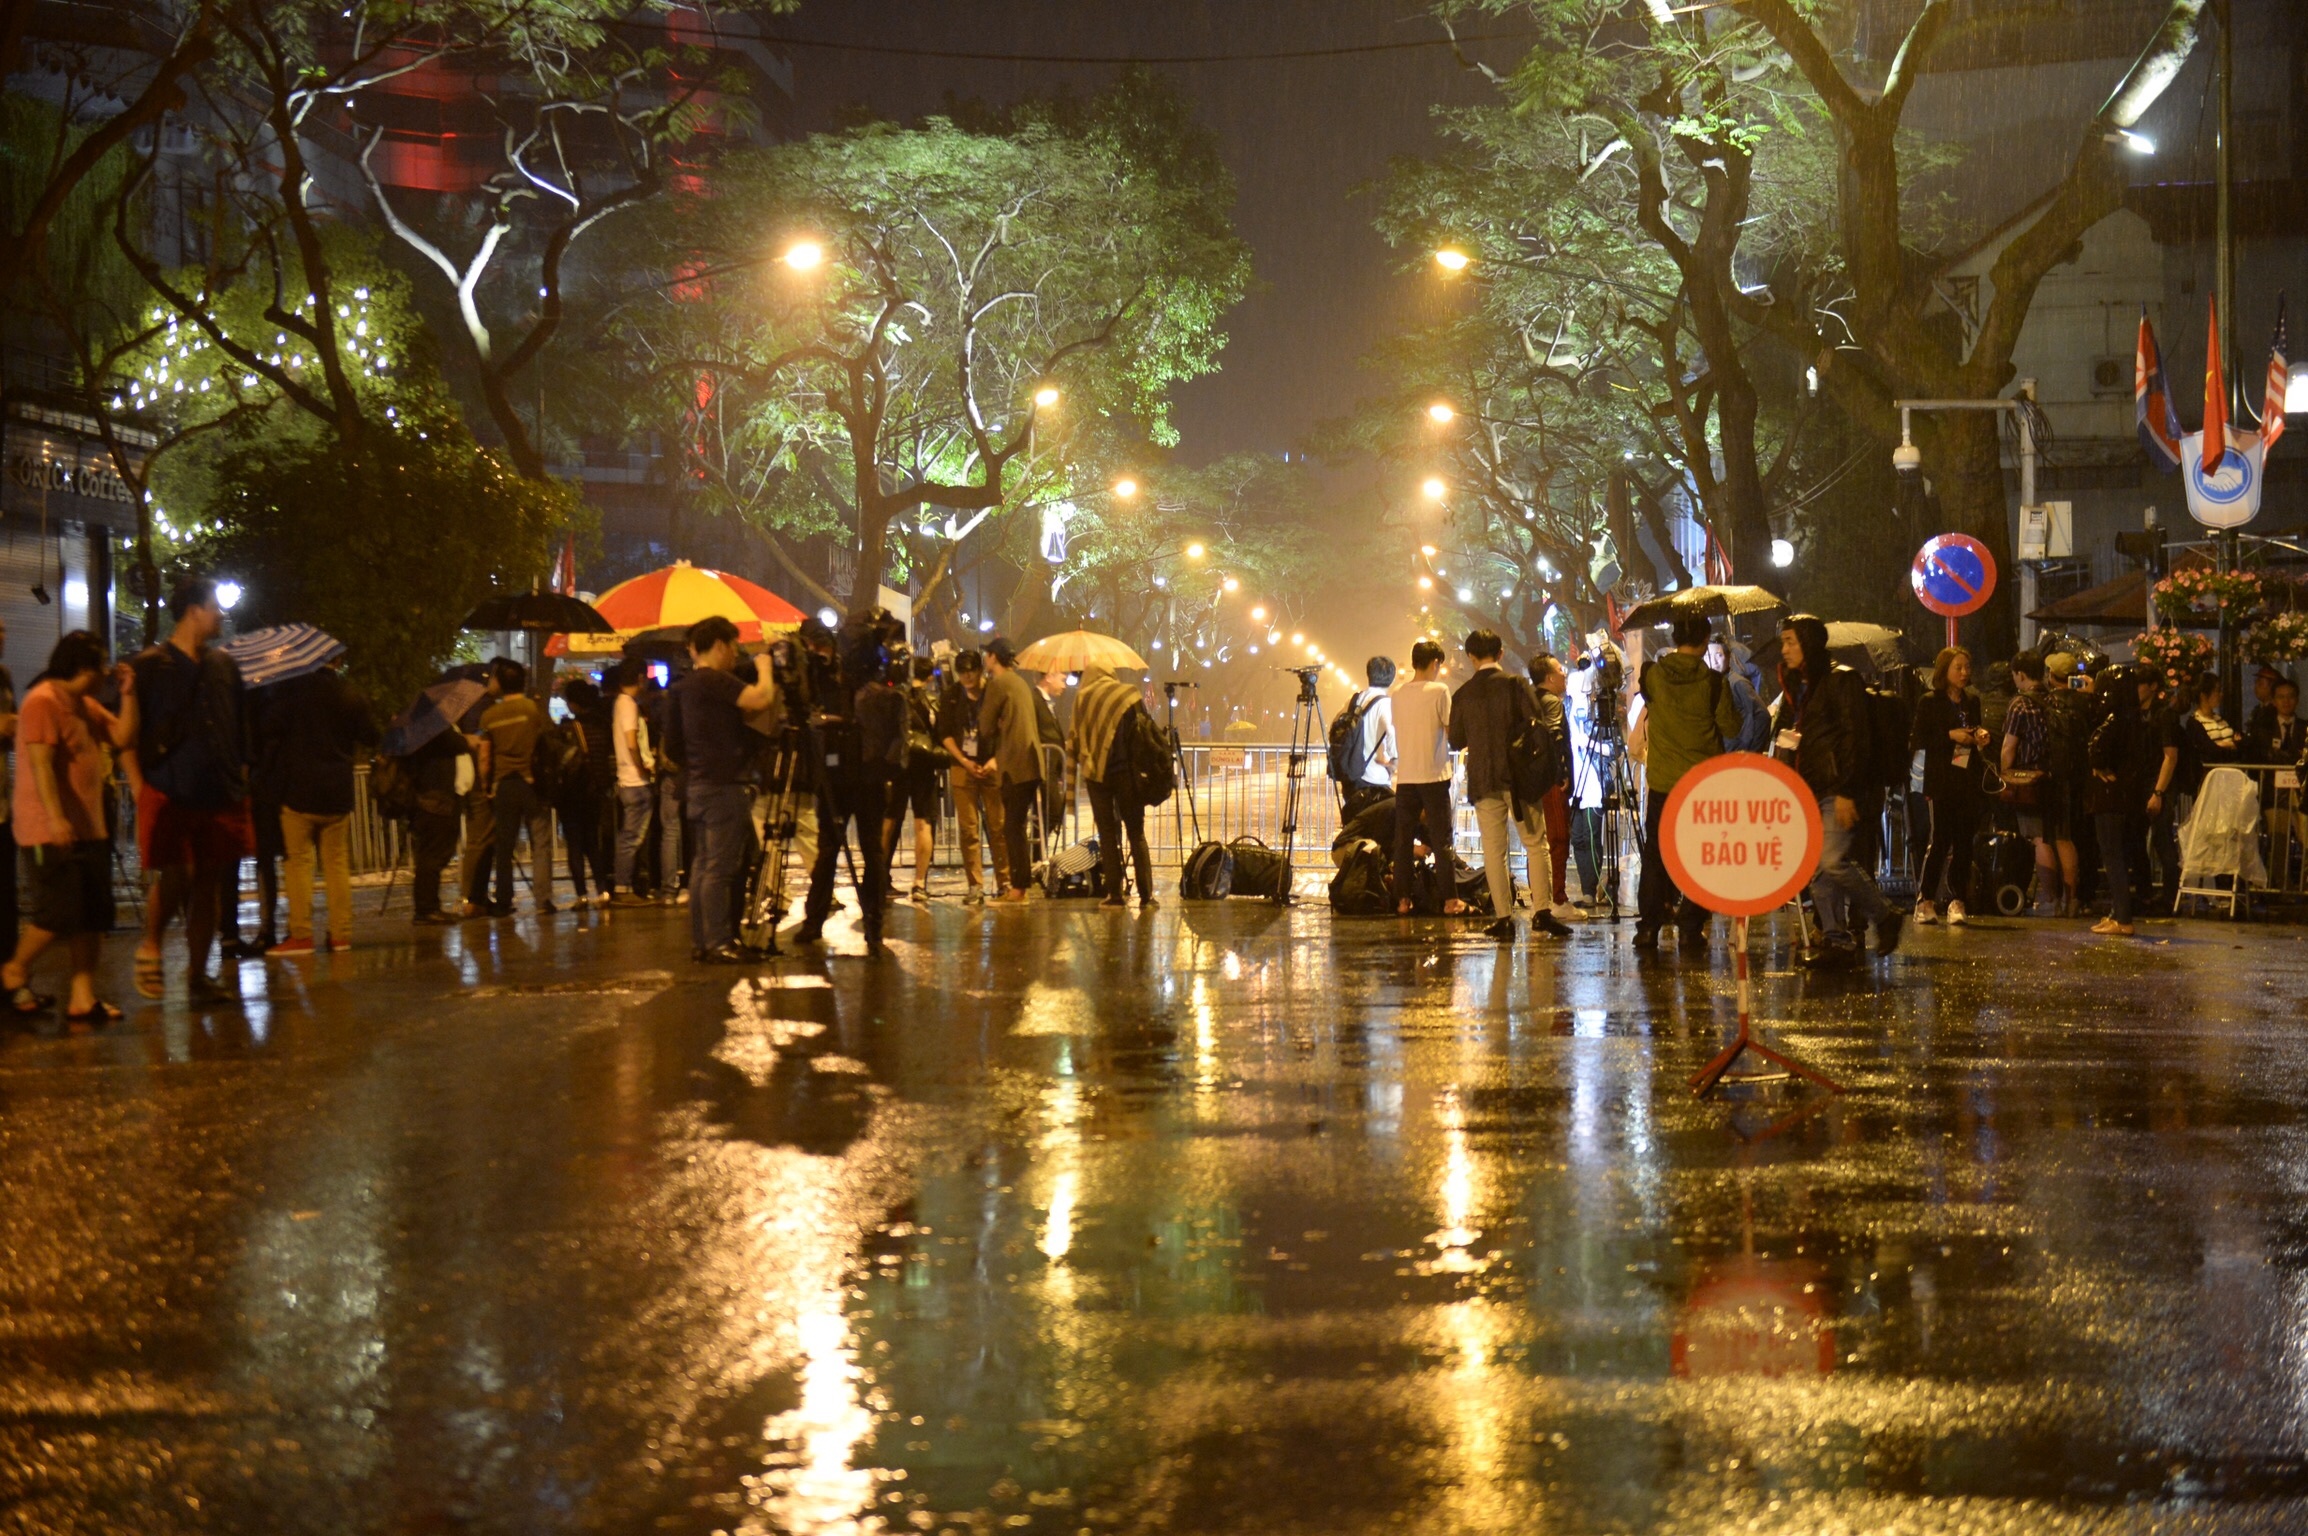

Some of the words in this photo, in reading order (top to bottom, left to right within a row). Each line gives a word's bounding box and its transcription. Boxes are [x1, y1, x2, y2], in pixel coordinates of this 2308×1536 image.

[1692, 800, 1739, 824] KHU
[1747, 798, 1791, 830] VỰC
[1702, 831, 1747, 866] BẢO
[1756, 836, 1782, 871] VỆ
